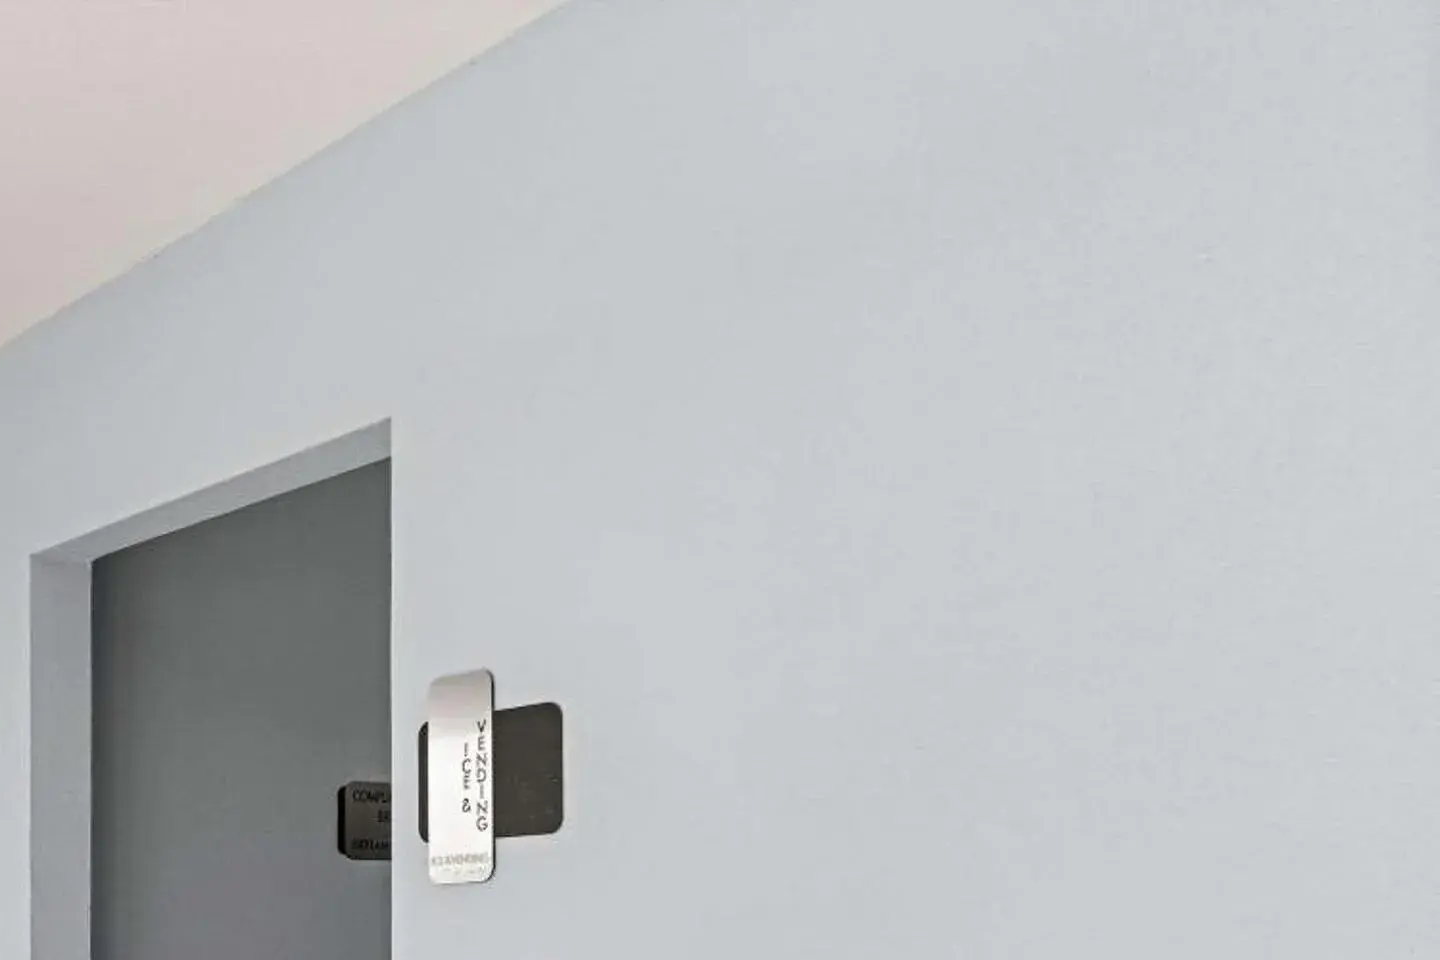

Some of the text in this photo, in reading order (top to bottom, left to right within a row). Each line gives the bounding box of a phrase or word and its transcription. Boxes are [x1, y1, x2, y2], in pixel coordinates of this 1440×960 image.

[462, 742, 471, 813] ICE &
[476, 718, 488, 832] VENDING
